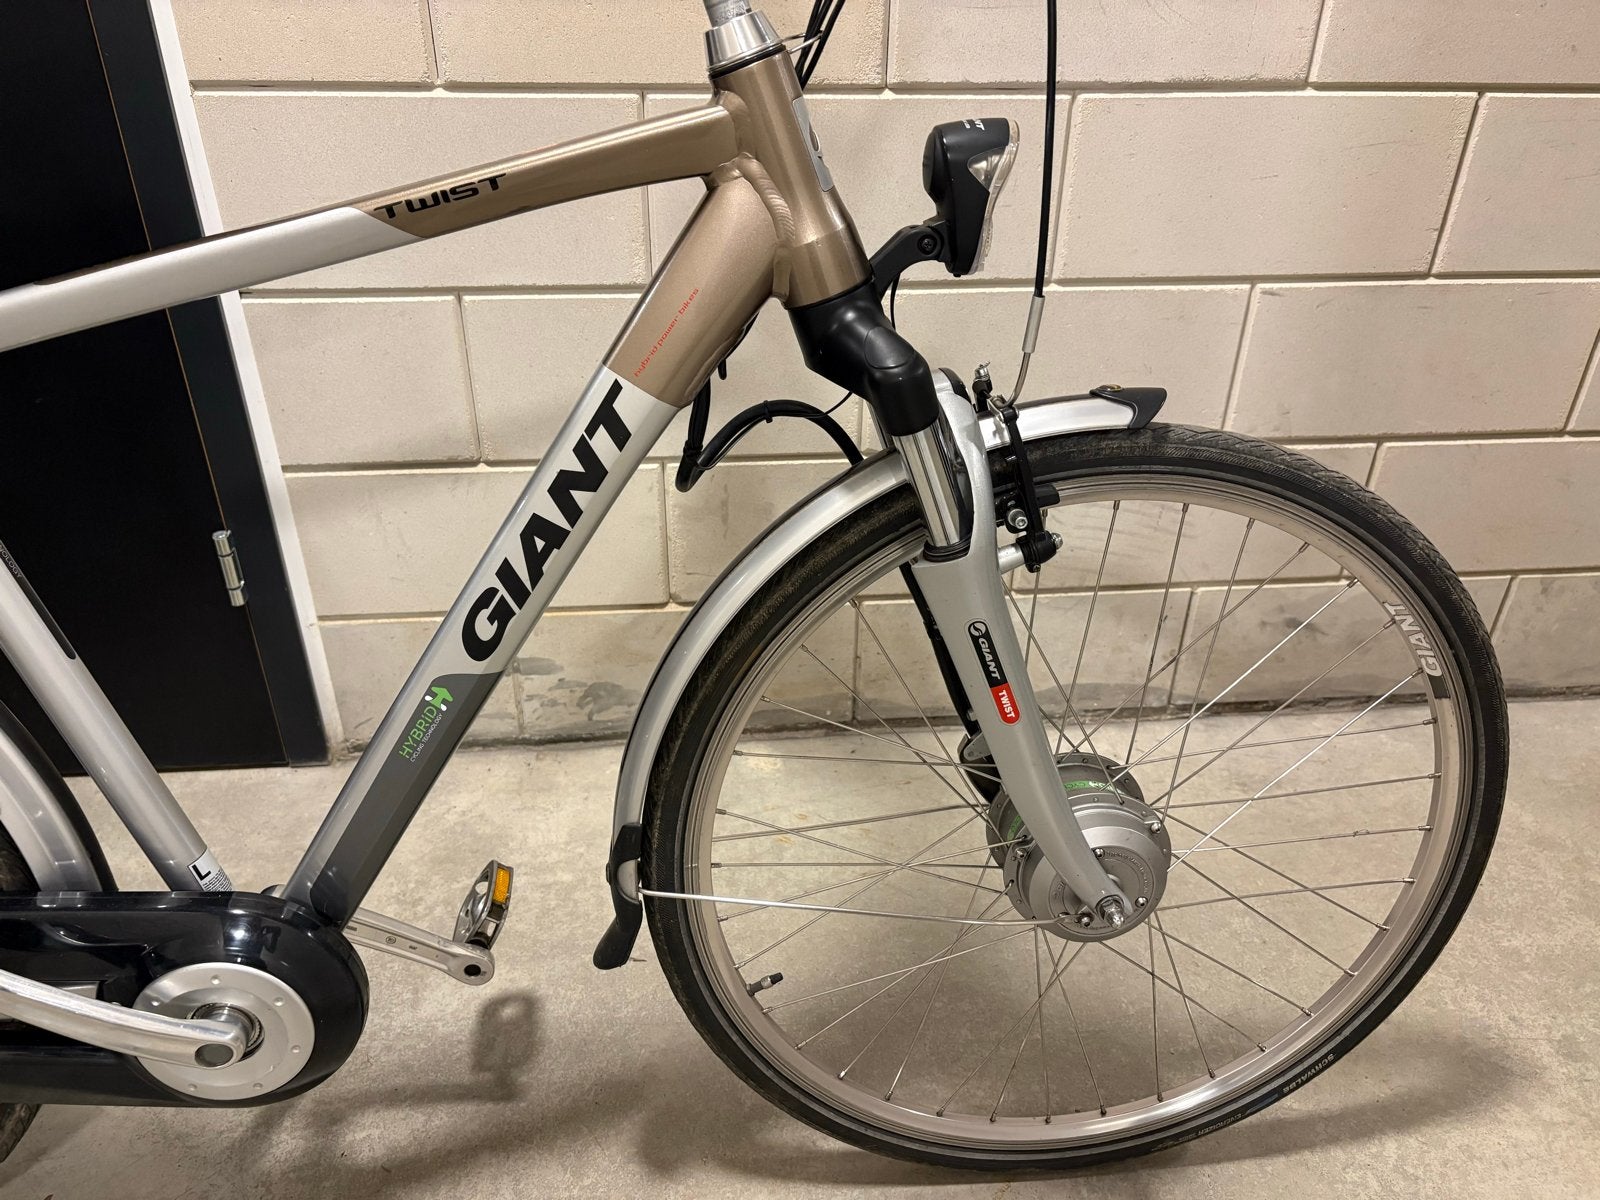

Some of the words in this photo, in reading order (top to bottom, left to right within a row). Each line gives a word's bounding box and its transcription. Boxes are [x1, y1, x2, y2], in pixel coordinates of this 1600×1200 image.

[373, 173, 507, 219] TWIST
[634, 345, 658, 377] hybrid
[657, 314, 679, 347] power
[678, 287, 699, 315] bikes
[462, 378, 632, 662] GIANT
[978, 637, 1001, 681] GIANT
[1382, 602, 1442, 677] GIANT
[998, 689, 1016, 718] TWIST
[422, 713, 443, 744] TECHNOLOGY
[191, 864, 212, 881] L
[1282, 1053, 1336, 1094] SCHWALBE
